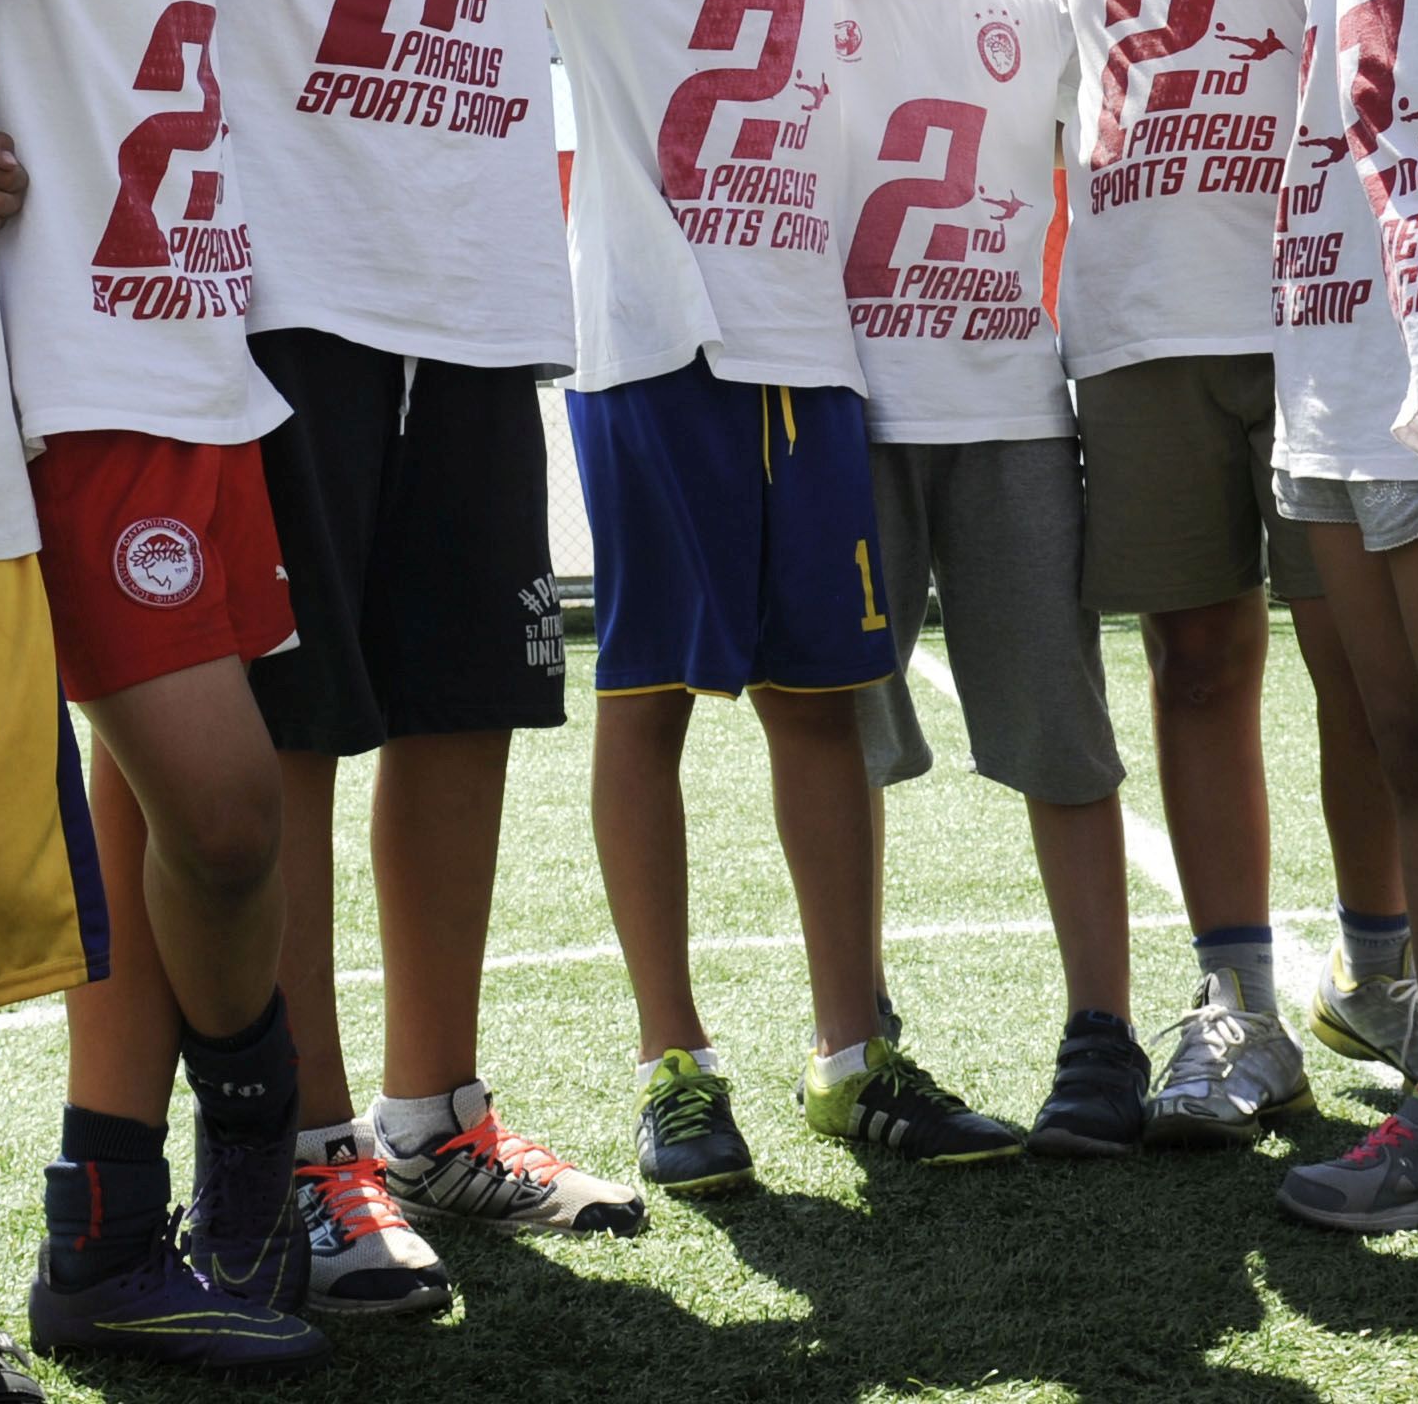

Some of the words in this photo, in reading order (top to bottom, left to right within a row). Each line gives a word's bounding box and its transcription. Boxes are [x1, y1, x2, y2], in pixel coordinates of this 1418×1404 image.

[392, 30, 503, 88] PIRAEUS
[296, 71, 445, 127] SPORTS
[448, 90, 529, 139] CAMP
[1127, 113, 1277, 157] PIRAEUS
[707, 164, 817, 210] PIRAEUS
[1091, 156, 1188, 215] SPORTS
[771, 211, 829, 255] CAMP
[92, 275, 226, 321] SPORTS
[900, 265, 1023, 303] PIRAEUS
[1291, 280, 1373, 327] CAMP
[847, 303, 958, 340] PORTS
[962, 306, 1041, 341] CAMP
[855, 540, 887, 632] 1
[526, 624, 538, 639] 57
